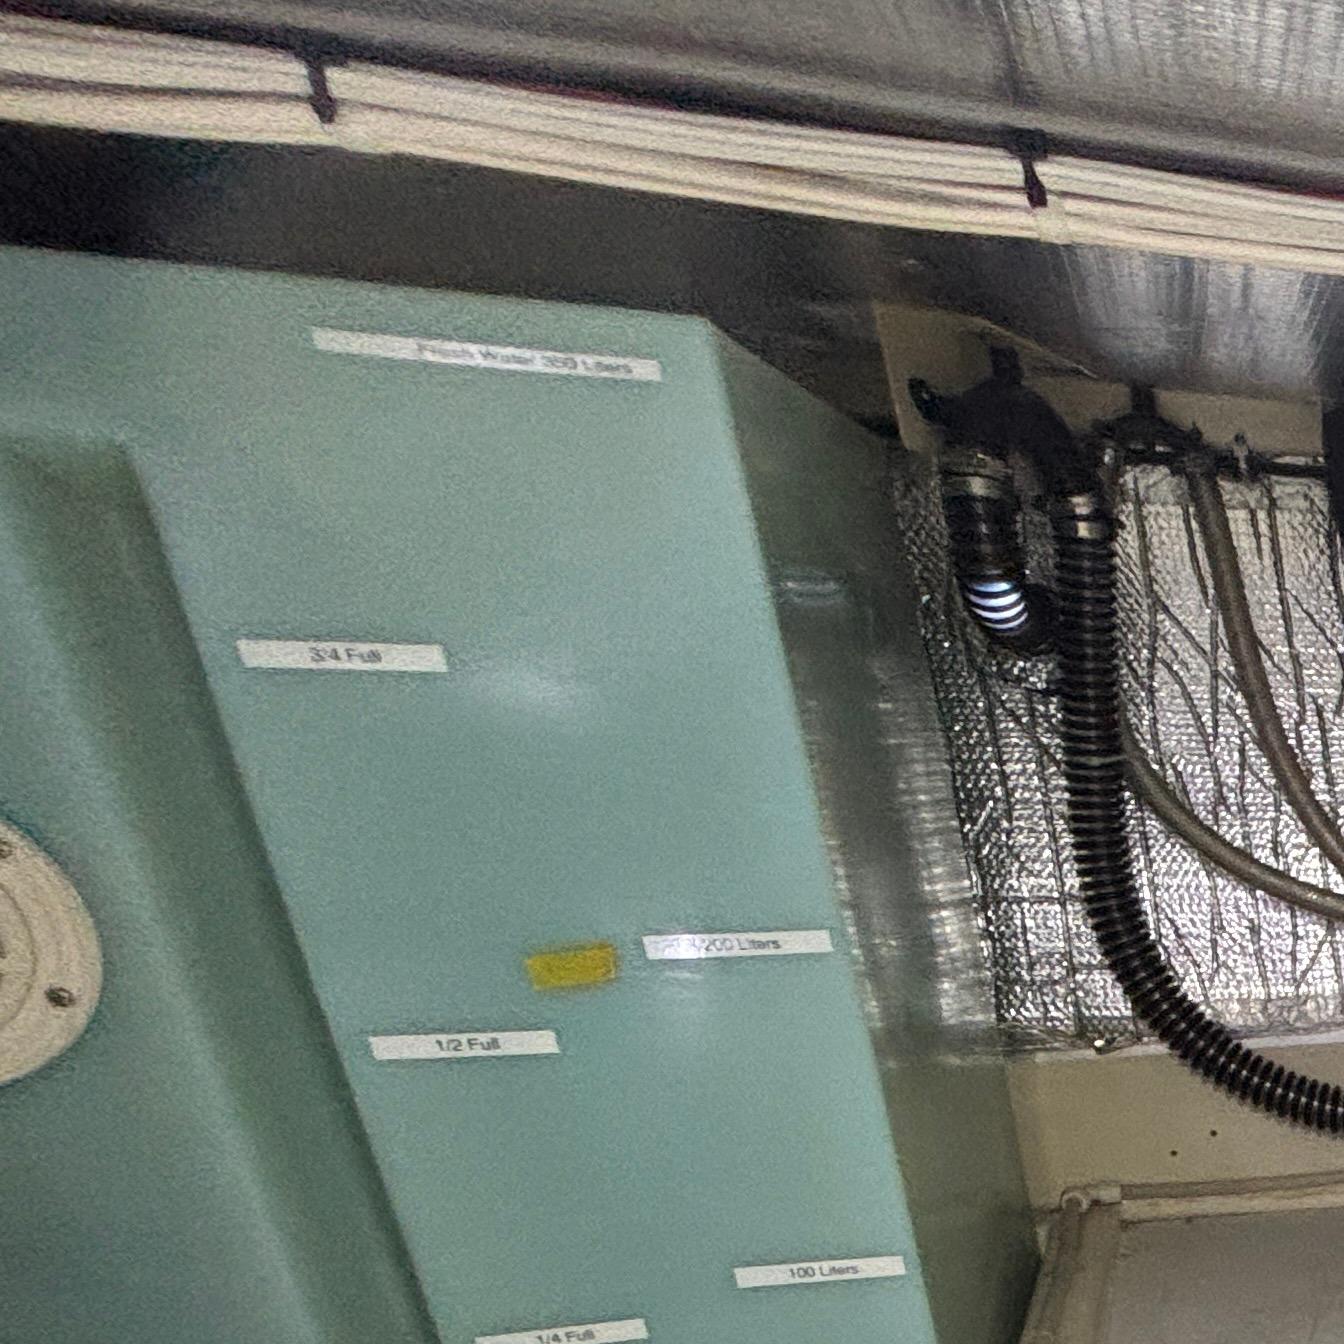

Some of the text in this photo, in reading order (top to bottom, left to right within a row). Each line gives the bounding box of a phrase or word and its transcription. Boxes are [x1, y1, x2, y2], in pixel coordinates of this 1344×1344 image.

[347, 648, 382, 663] Full
[435, 1037, 501, 1051] 1/2 Full
[789, 1264, 859, 1278] 100 Liters
[536, 1330, 595, 1344] 1/4 Full
